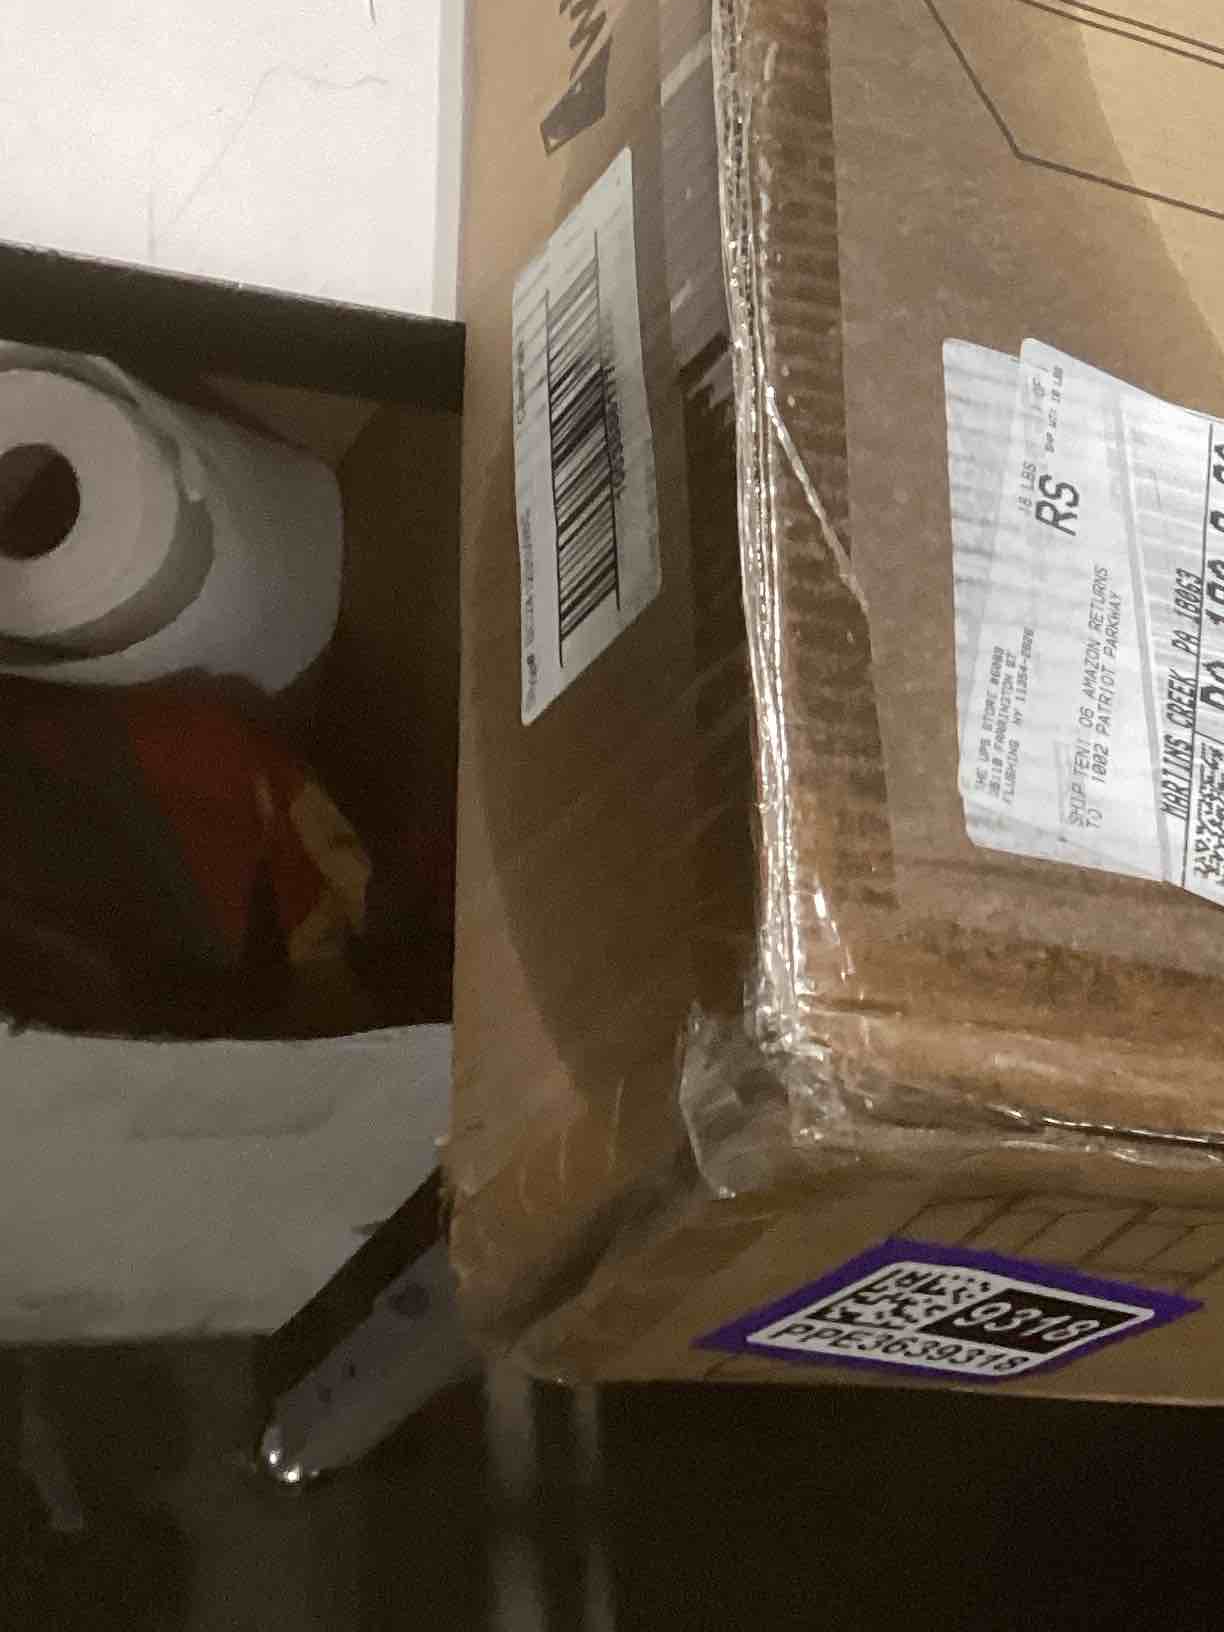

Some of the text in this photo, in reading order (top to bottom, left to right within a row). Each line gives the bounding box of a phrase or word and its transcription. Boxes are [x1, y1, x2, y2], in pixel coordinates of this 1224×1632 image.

[1034, 473, 1081, 537] RS
[1088, 565, 1110, 632] RETURNS
[1103, 590, 1123, 658] PARKWAY
[1081, 637, 1102, 700] AMAZON
[1171, 628, 1201, 657] PA
[1094, 665, 1116, 738] PATRIOT
[1165, 667, 1198, 730] CREEK
[1067, 781, 1087, 828] SHIP
[1160, 733, 1193, 821] MARTINS
[767, 1322, 1032, 1372] PPE3639318
[951, 1300, 1103, 1344] 9318
